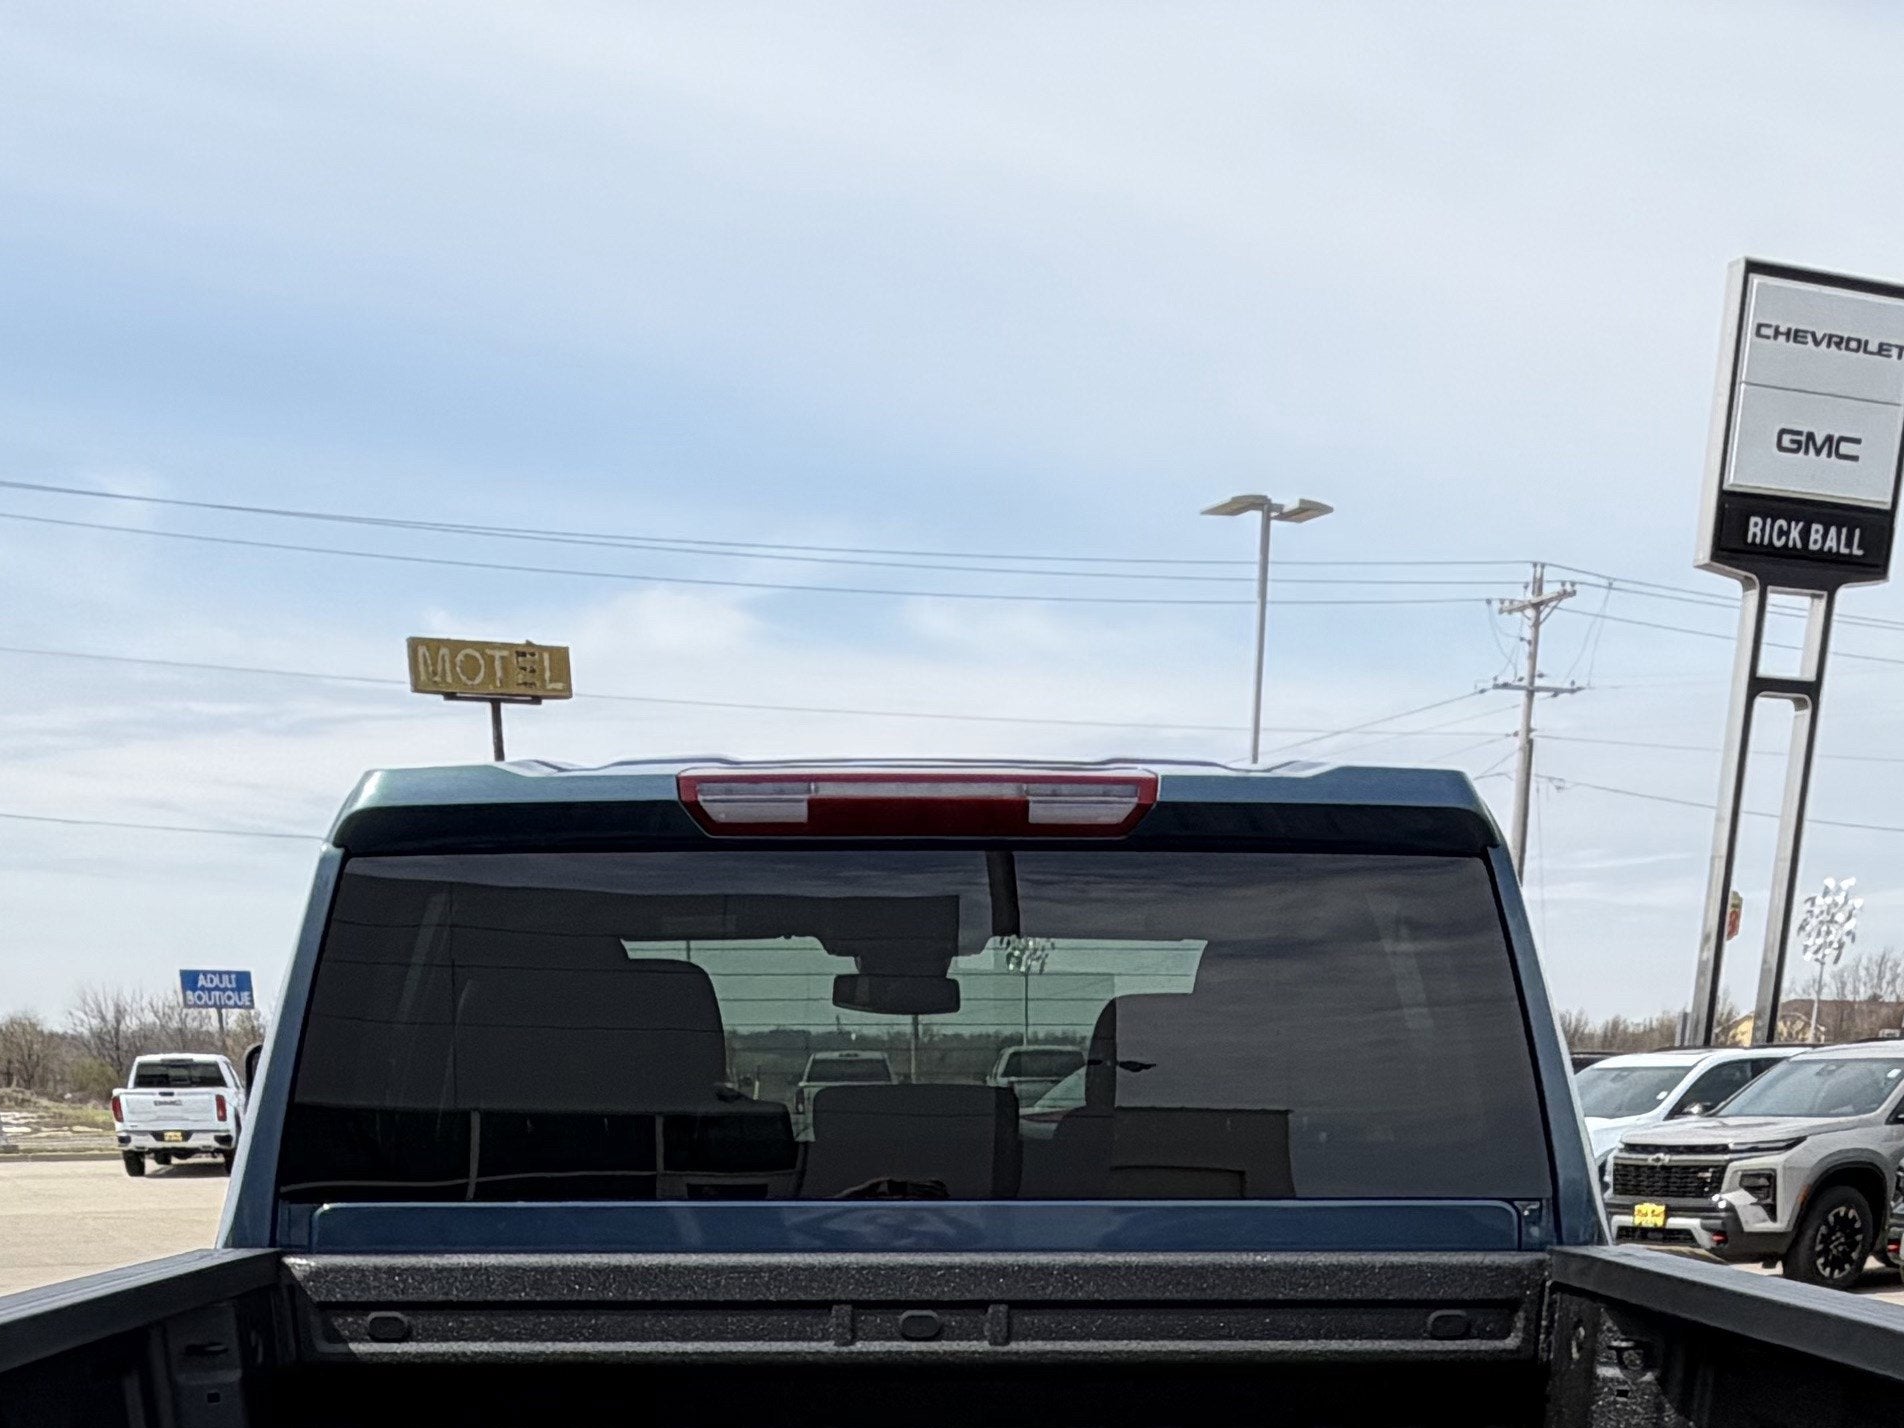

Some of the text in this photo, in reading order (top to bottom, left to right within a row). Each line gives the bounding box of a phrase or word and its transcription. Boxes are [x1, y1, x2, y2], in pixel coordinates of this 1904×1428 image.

[1776, 427, 1863, 462] GMC
[1747, 515, 1865, 556] RICK BALL
[417, 644, 566, 690] MOTEL
[197, 972, 236, 988] ADULT
[185, 990, 252, 1006] BOUTIQUE
